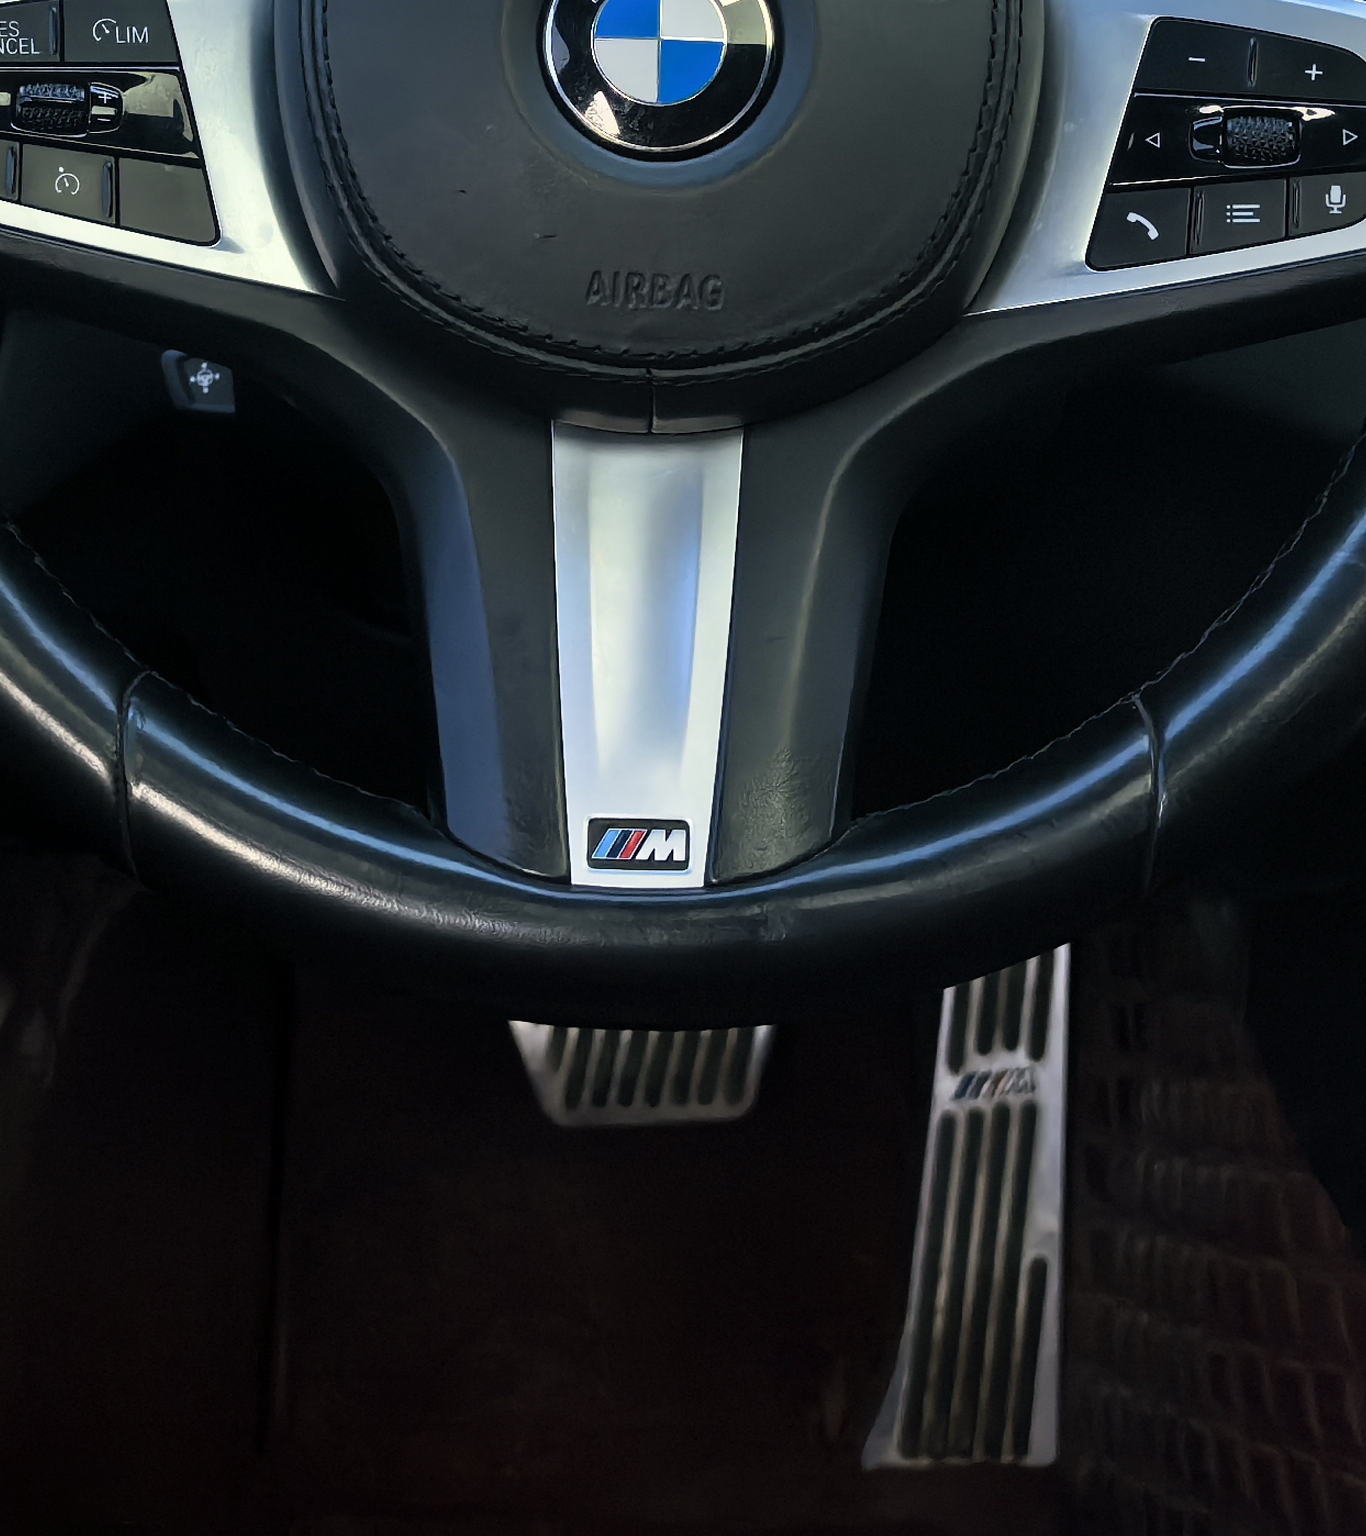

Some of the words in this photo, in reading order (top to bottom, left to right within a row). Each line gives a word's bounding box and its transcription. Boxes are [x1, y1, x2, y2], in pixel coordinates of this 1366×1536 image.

[115, 26, 149, 44] LIM
[586, 270, 725, 311] AIRBAG
[635, 829, 687, 862] M
